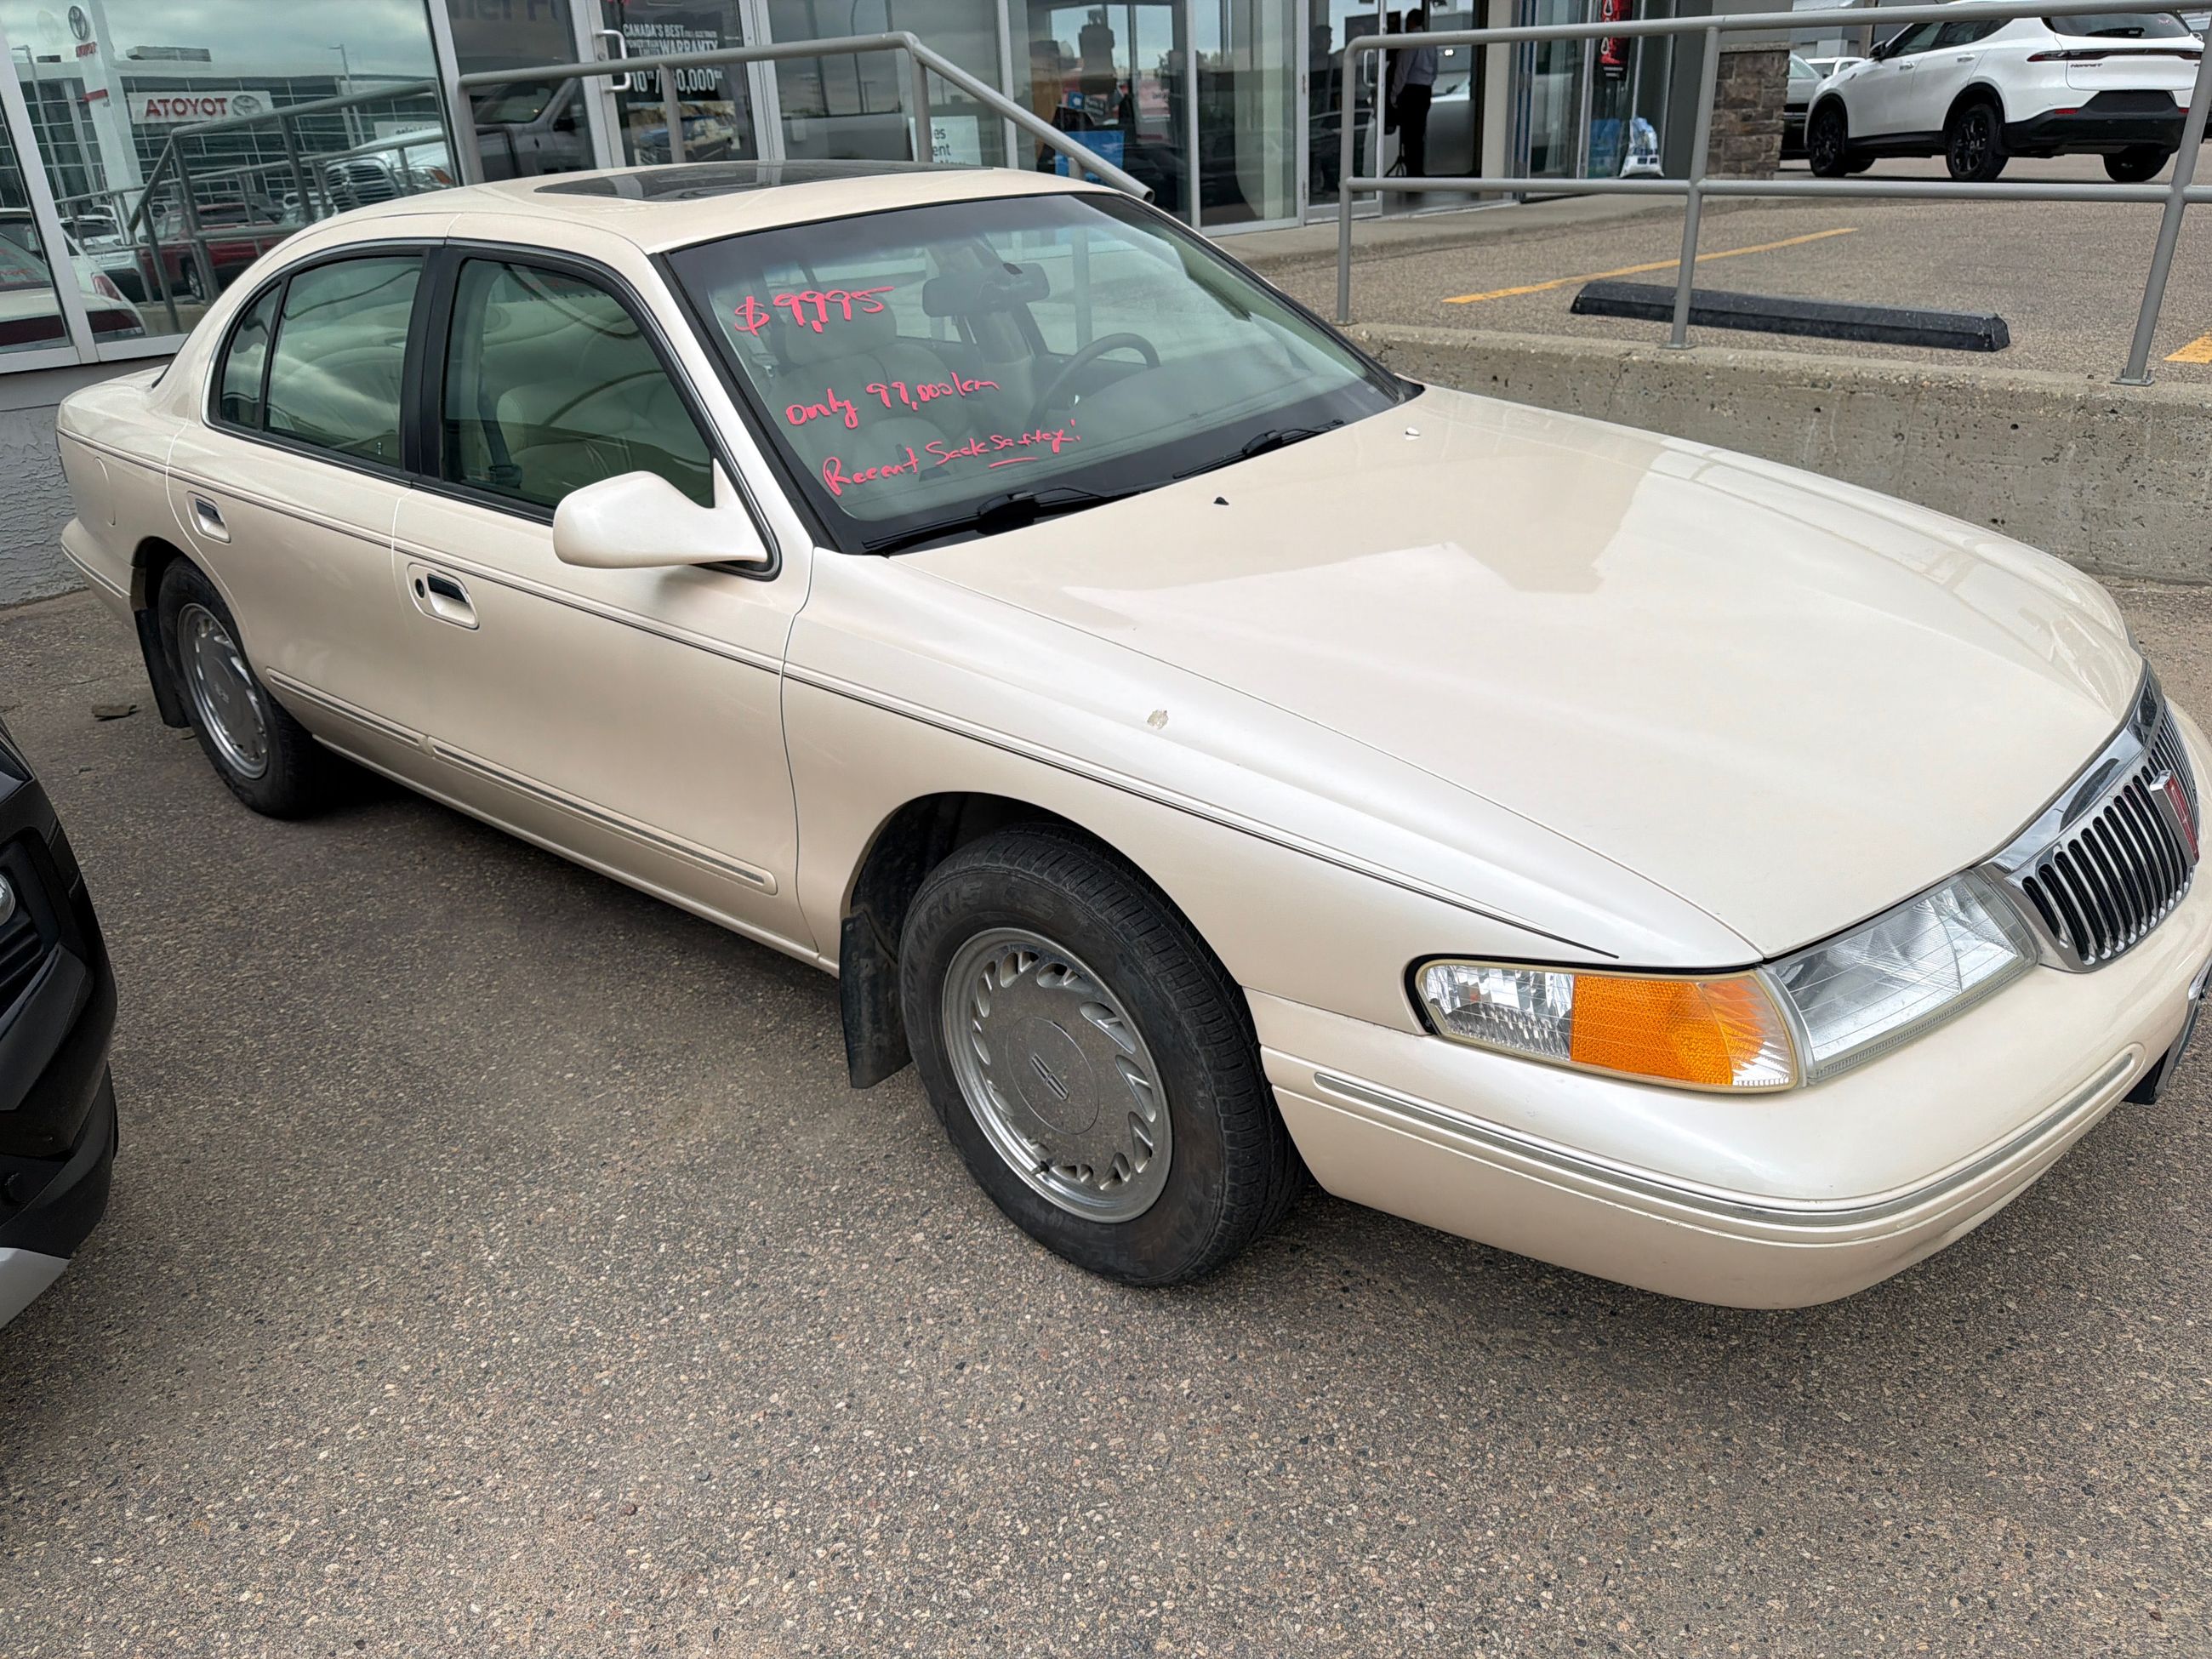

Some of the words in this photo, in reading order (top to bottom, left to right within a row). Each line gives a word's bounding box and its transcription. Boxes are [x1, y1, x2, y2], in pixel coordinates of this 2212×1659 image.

[623, 24, 664, 37] CANADA'S
[664, 24, 685, 37] BEST
[659, 39, 718, 56] WARRANTY
[823, 456, 919, 496] Recent
